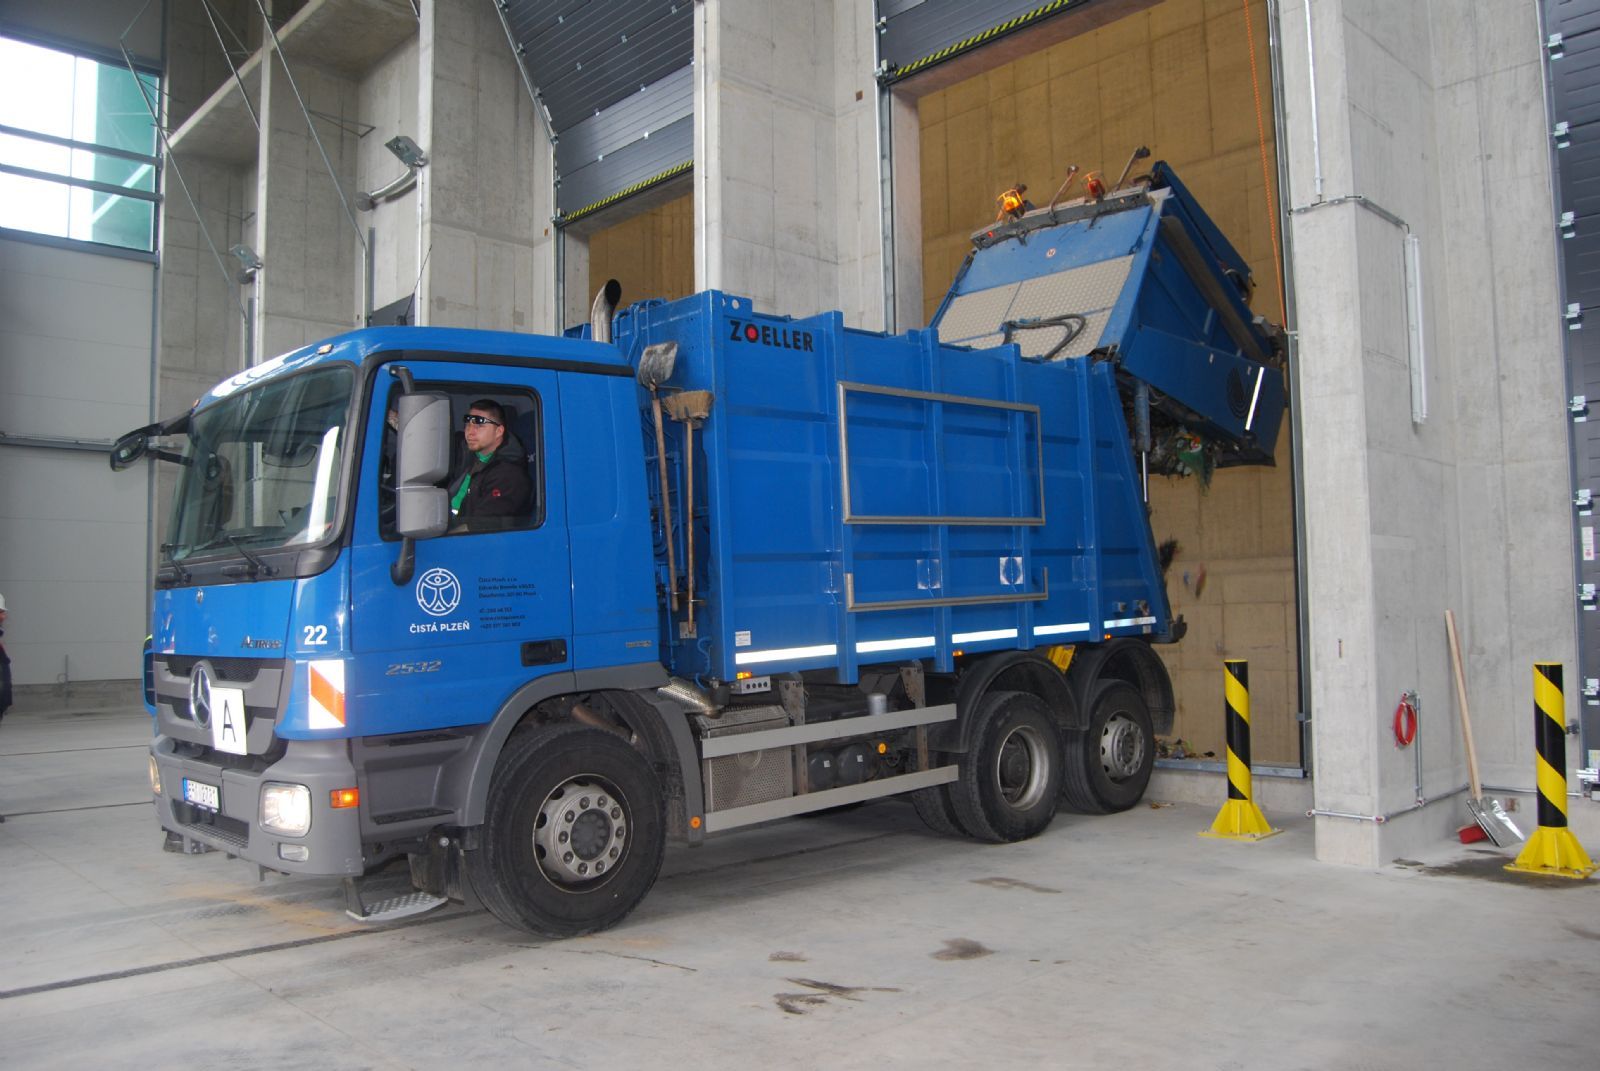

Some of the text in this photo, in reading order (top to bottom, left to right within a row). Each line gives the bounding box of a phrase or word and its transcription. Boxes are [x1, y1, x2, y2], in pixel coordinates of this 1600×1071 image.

[730, 320, 814, 352] ZOELLER
[304, 625, 328, 645] 22
[410, 621, 438, 633] ČISTÁ
[440, 620, 470, 632] PLZEŇ
[385, 659, 442, 676] 2532
[222, 699, 236, 742] A
